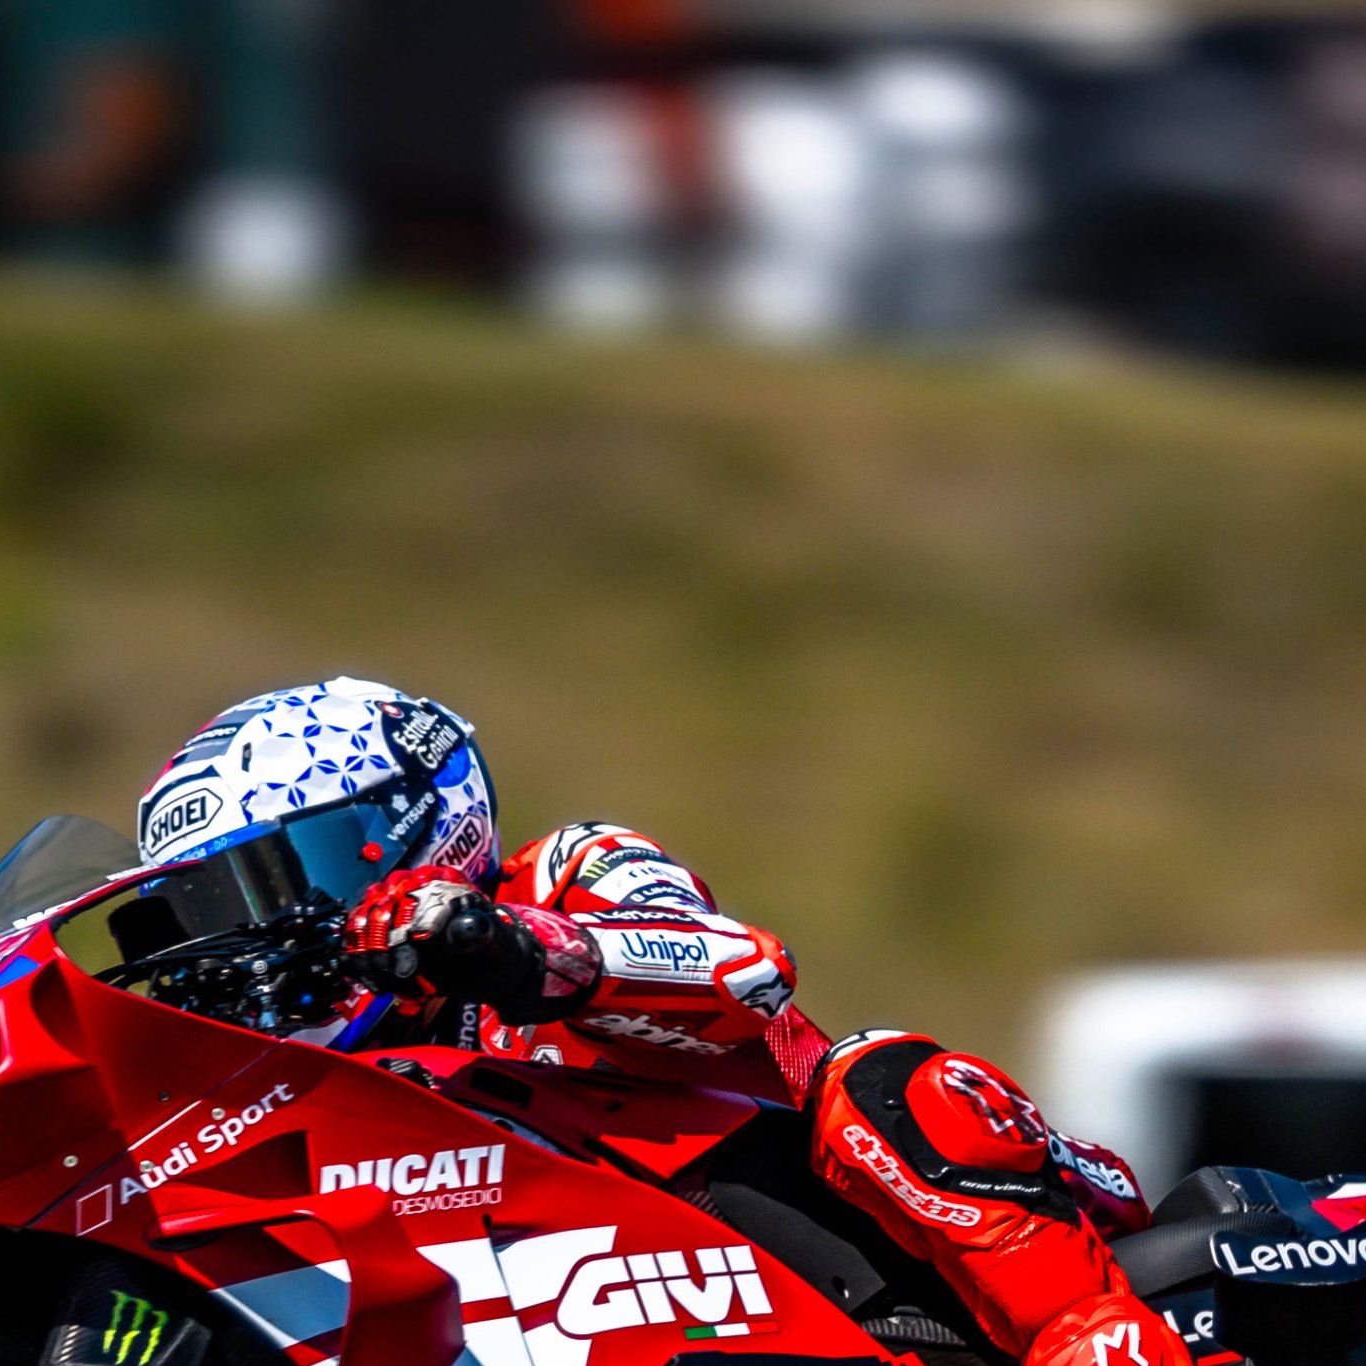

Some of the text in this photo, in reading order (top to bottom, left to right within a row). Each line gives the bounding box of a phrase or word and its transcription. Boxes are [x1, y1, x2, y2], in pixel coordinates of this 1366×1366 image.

[150, 795, 207, 849] SHOEI
[387, 791, 435, 841] verisure
[621, 932, 709, 971] Unipol
[120, 1083, 294, 1205] Audi Sport
[320, 1143, 506, 1196] DUCATI
[555, 1245, 773, 1336] GIVI
